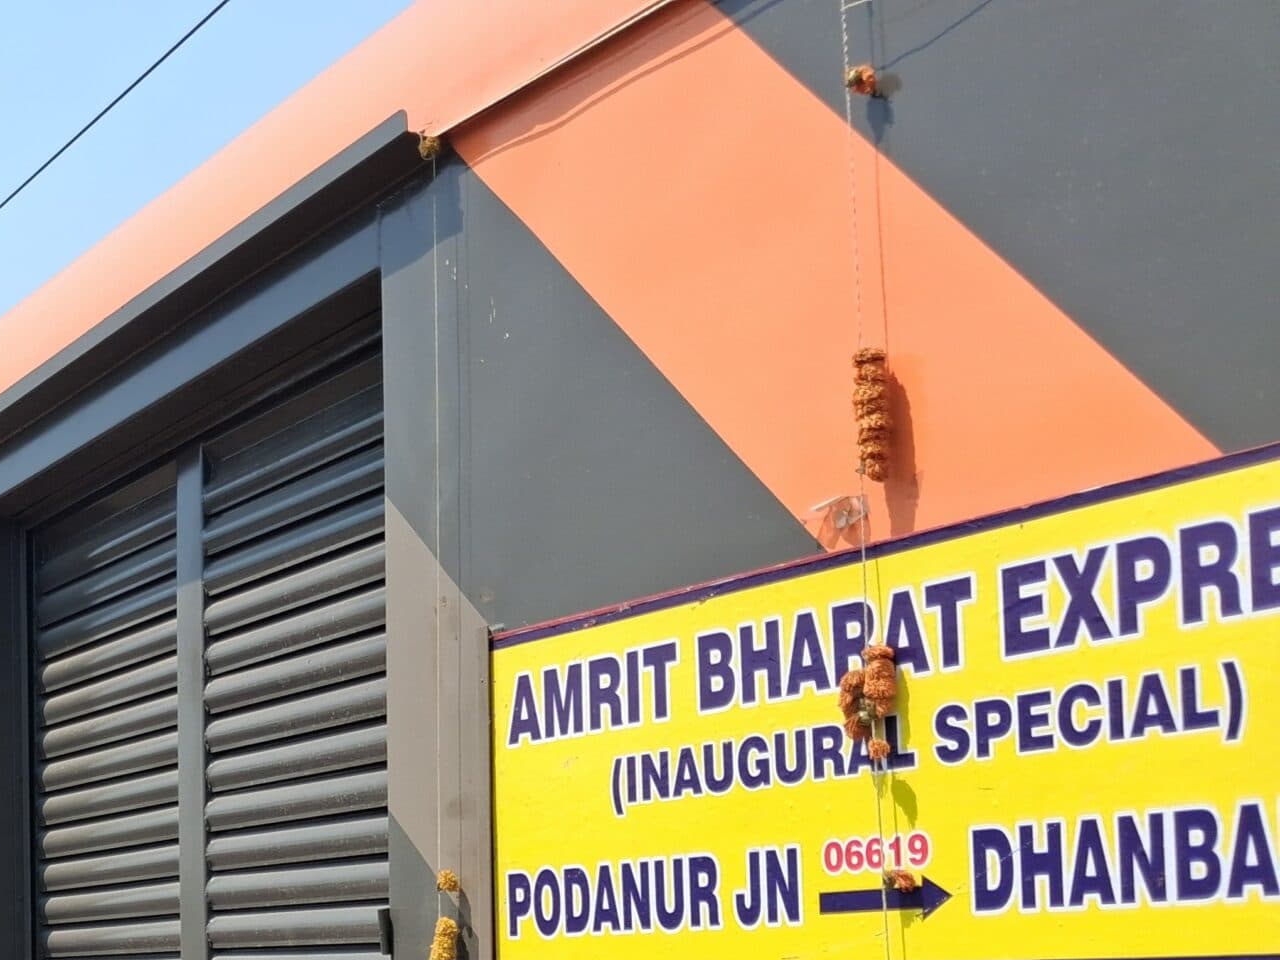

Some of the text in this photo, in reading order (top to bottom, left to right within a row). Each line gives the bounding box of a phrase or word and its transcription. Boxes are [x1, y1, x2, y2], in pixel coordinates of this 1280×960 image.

[509, 506, 1280, 746] AMRIT BHARAT EXPRE
[935, 660, 1243, 764] SPECIAL)
[508, 800, 1280, 938] PODANUR JN 06619 DHANBA
